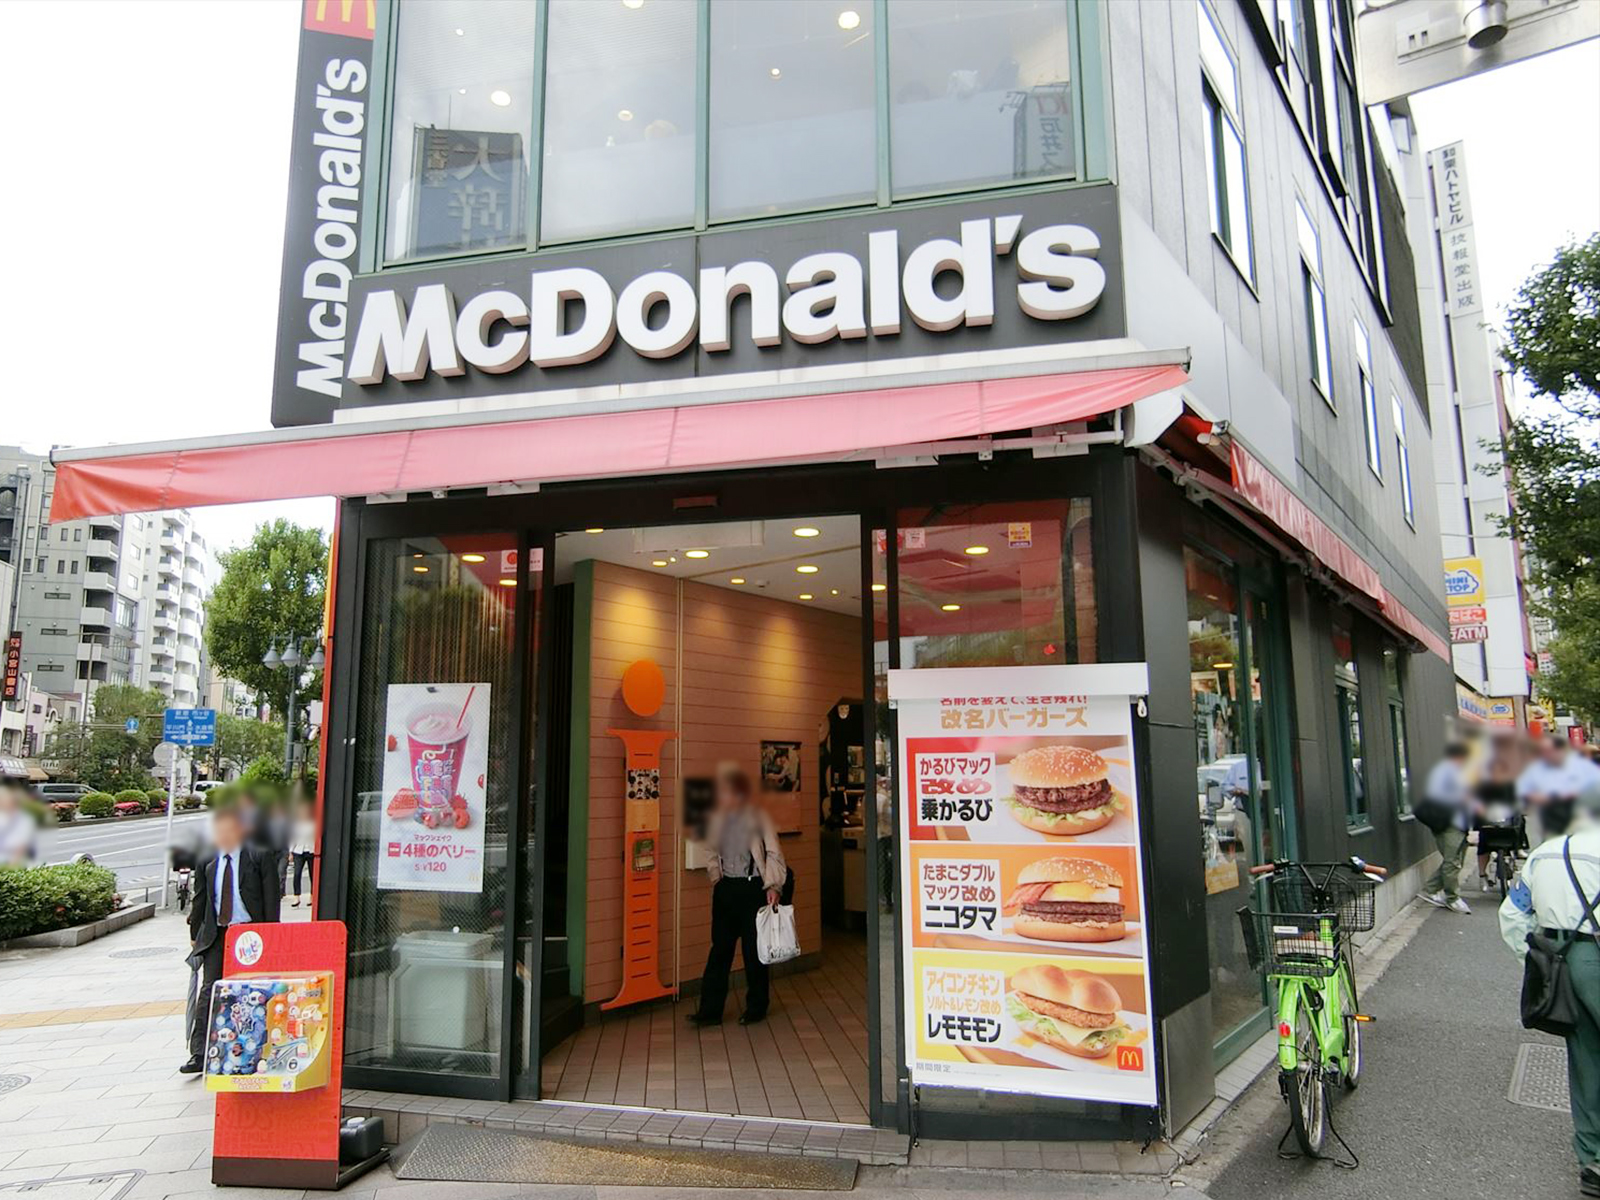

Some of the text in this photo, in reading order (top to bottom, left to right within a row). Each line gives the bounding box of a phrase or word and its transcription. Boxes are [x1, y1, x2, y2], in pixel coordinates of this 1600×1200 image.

[296, 58, 368, 399] McDonald's
[347, 214, 1107, 386] McDonald's
[940, 706, 1088, 730] 改名バーガーズ
[920, 757, 991, 776] かるびマック
[402, 842, 477, 859] 4種のベリー
[923, 863, 996, 883] たまごダブル
[924, 884, 997, 903] マック改め
[925, 905, 998, 932] ニコタマ
[926, 970, 1001, 996] アイコンチキン
[927, 1013, 1002, 1043] レモモモン
